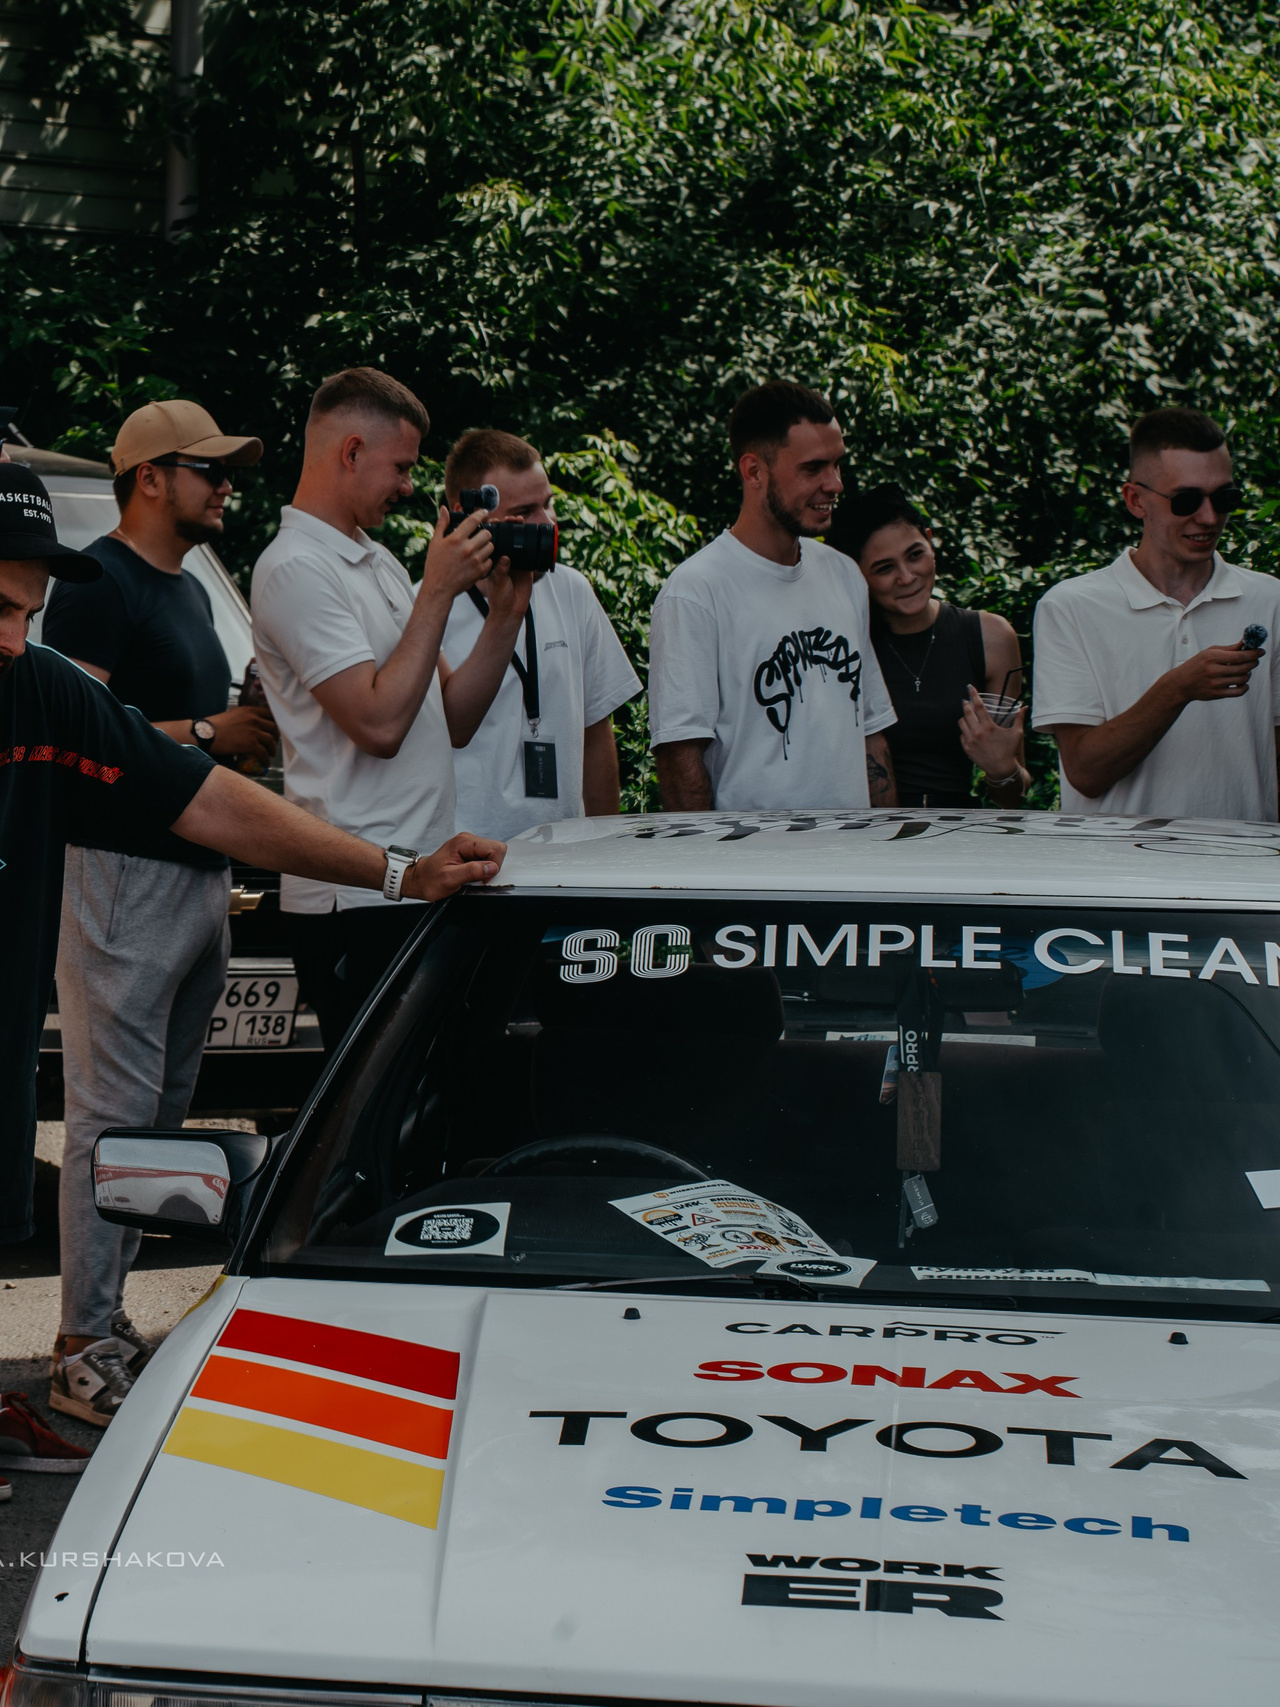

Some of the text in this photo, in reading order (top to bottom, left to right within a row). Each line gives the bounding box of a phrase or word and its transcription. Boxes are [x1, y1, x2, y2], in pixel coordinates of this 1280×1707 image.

[560, 925, 691, 984] SC
[713, 924, 1002, 970] SIMPLE
[225, 981, 281, 1008] 669
[245, 1015, 286, 1037] 138
[246, 1036, 268, 1046] RUS
[725, 1321, 1039, 1346] CARPRO
[693, 1359, 1084, 1399] SONAX
[528, 1409, 1249, 1480] TOYOTA
[601, 1485, 1190, 1542] Simpletech
[745, 1553, 1006, 1582] WORK
[741, 1573, 1006, 1621] ER
